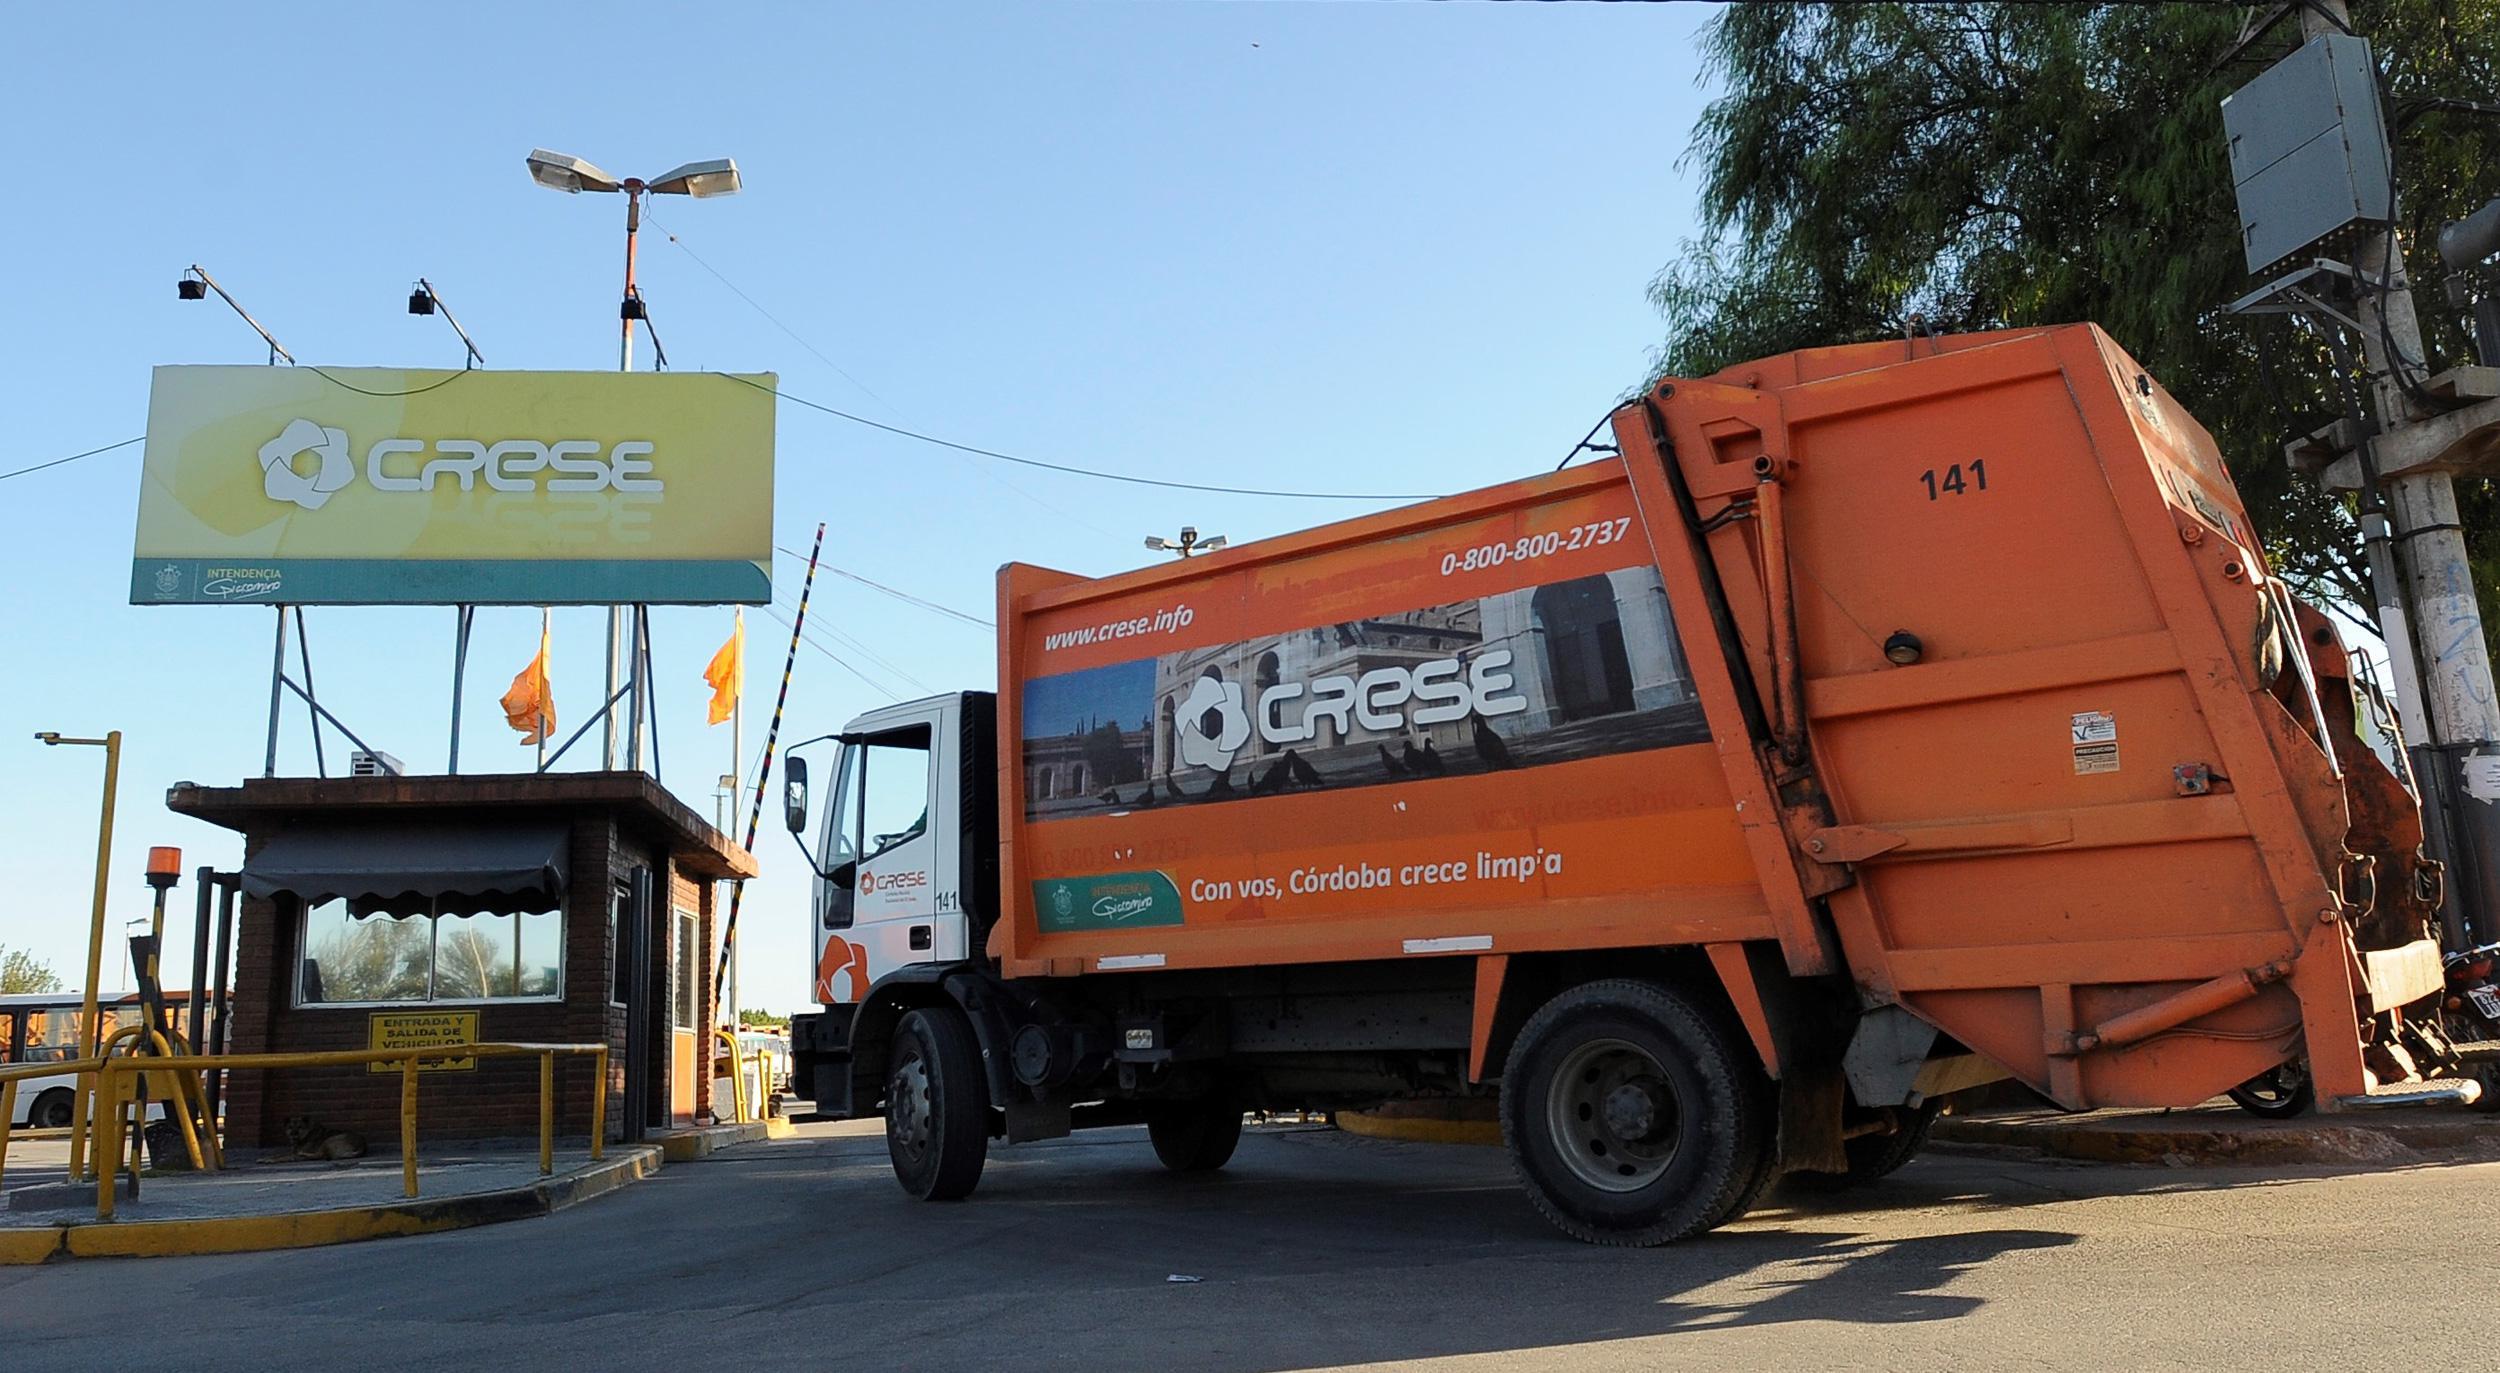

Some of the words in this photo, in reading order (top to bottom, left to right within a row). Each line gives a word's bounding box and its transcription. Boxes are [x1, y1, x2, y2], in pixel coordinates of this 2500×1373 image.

[366, 438, 665, 492] CRESE
[1919, 457, 1988, 502] 141
[1440, 516, 1632, 577] 0-800-800-2737
[1044, 604, 1194, 651] www.crese.info
[1257, 649, 1528, 744] CRESE
[876, 870, 928, 890] CRESE
[936, 890, 958, 911] 141
[1190, 878, 1232, 902] Con
[1237, 877, 1284, 900] vos,
[1289, 862, 1392, 895] Córdoba
[1399, 861, 1468, 886] crece
[383, 1017, 451, 1028] ENTRADA
[455, 1017, 465, 1026] Y
[386, 1028, 438, 1038] SALIDA
[442, 1027, 461, 1036] DE
